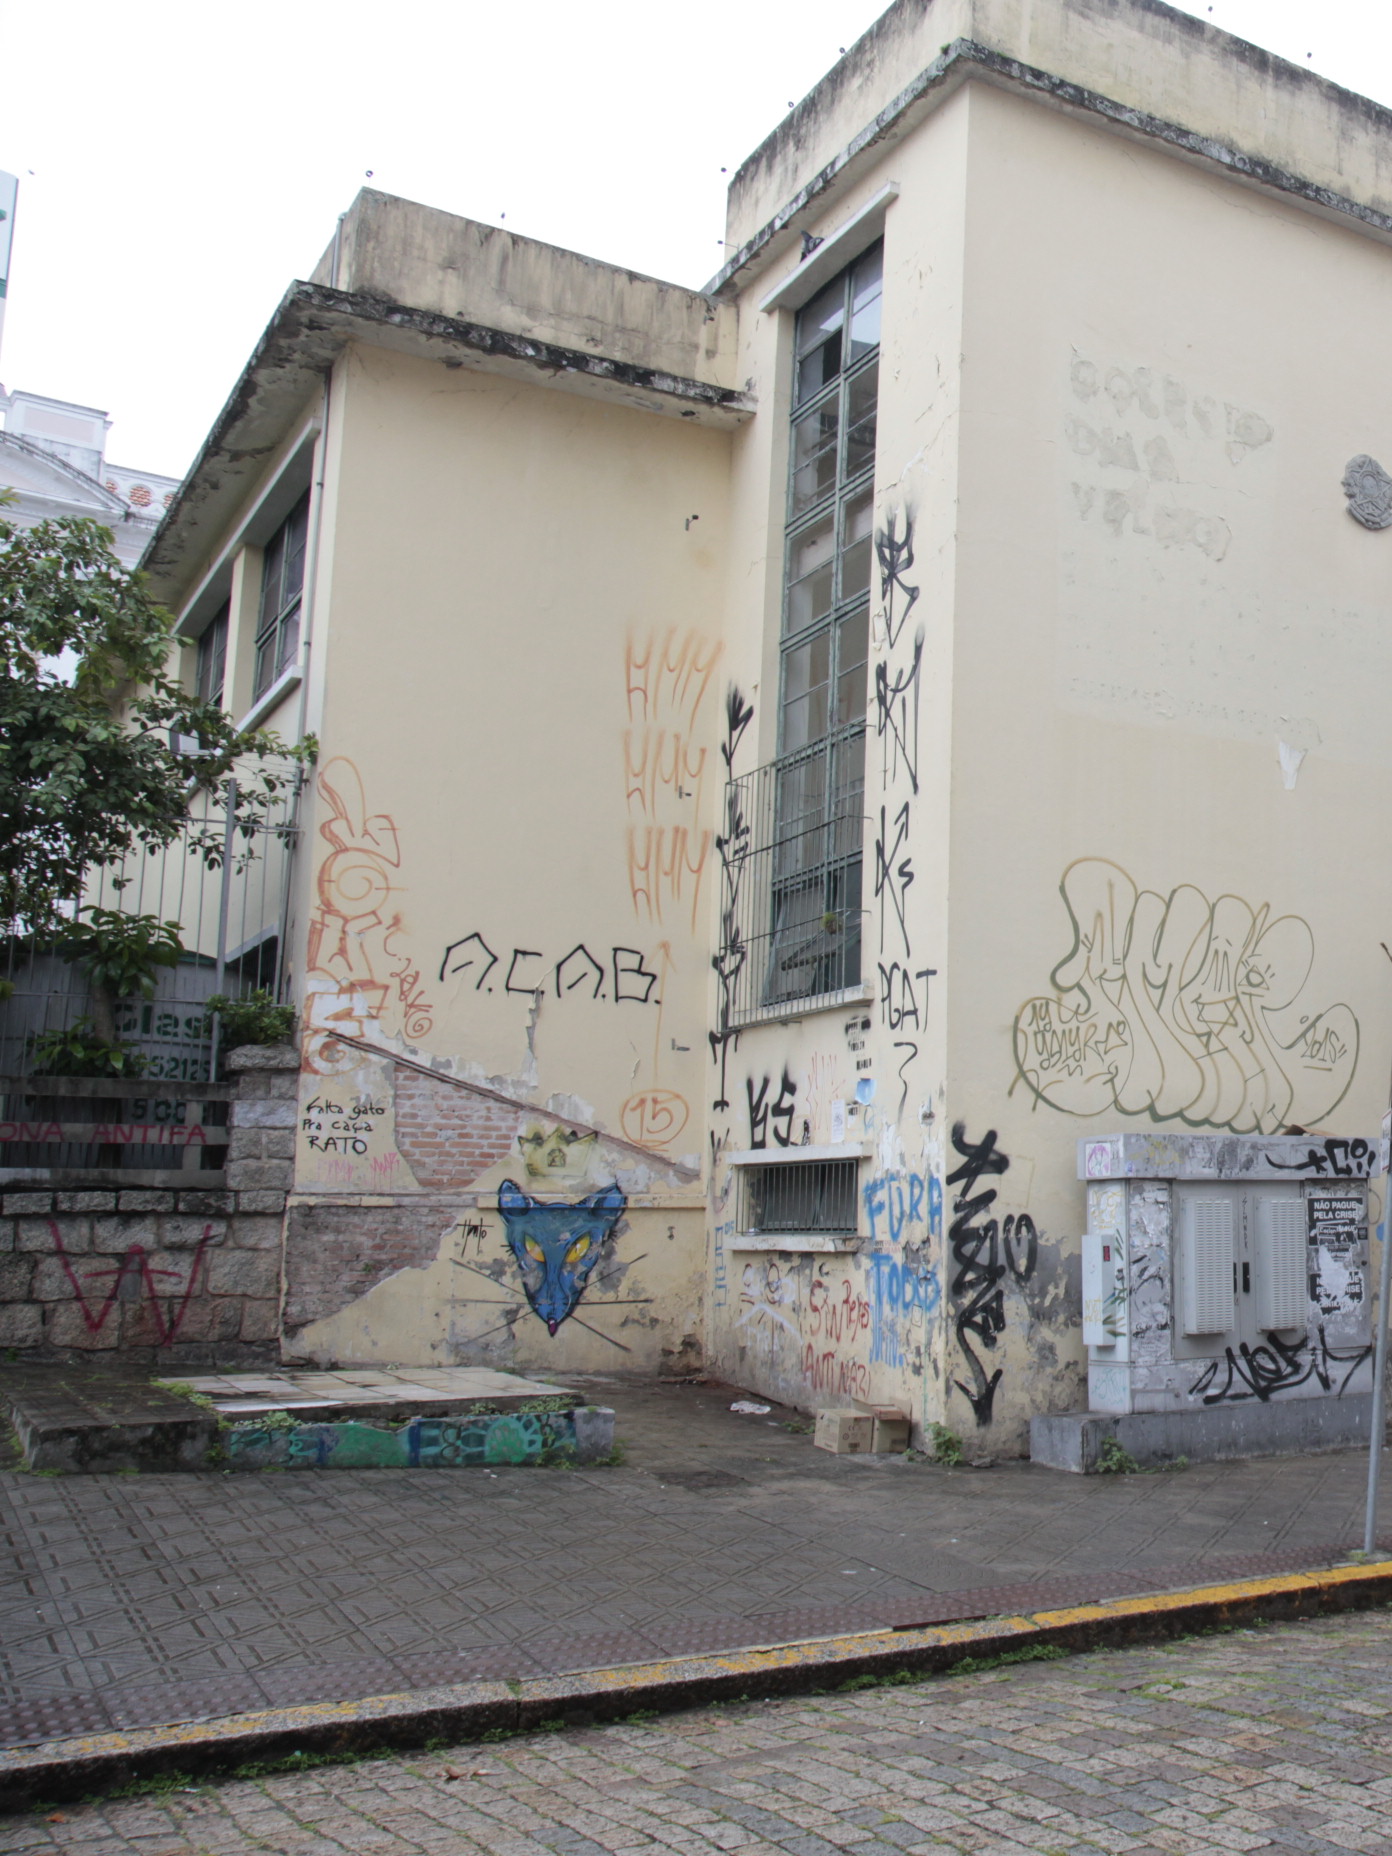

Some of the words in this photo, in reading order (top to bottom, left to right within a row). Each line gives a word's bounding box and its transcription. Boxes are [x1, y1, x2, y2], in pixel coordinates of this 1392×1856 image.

[92, 1123, 207, 1145] ANTIFA
[306, 1135, 368, 1155] RATO
[1313, 1210, 1333, 1219] PELA
